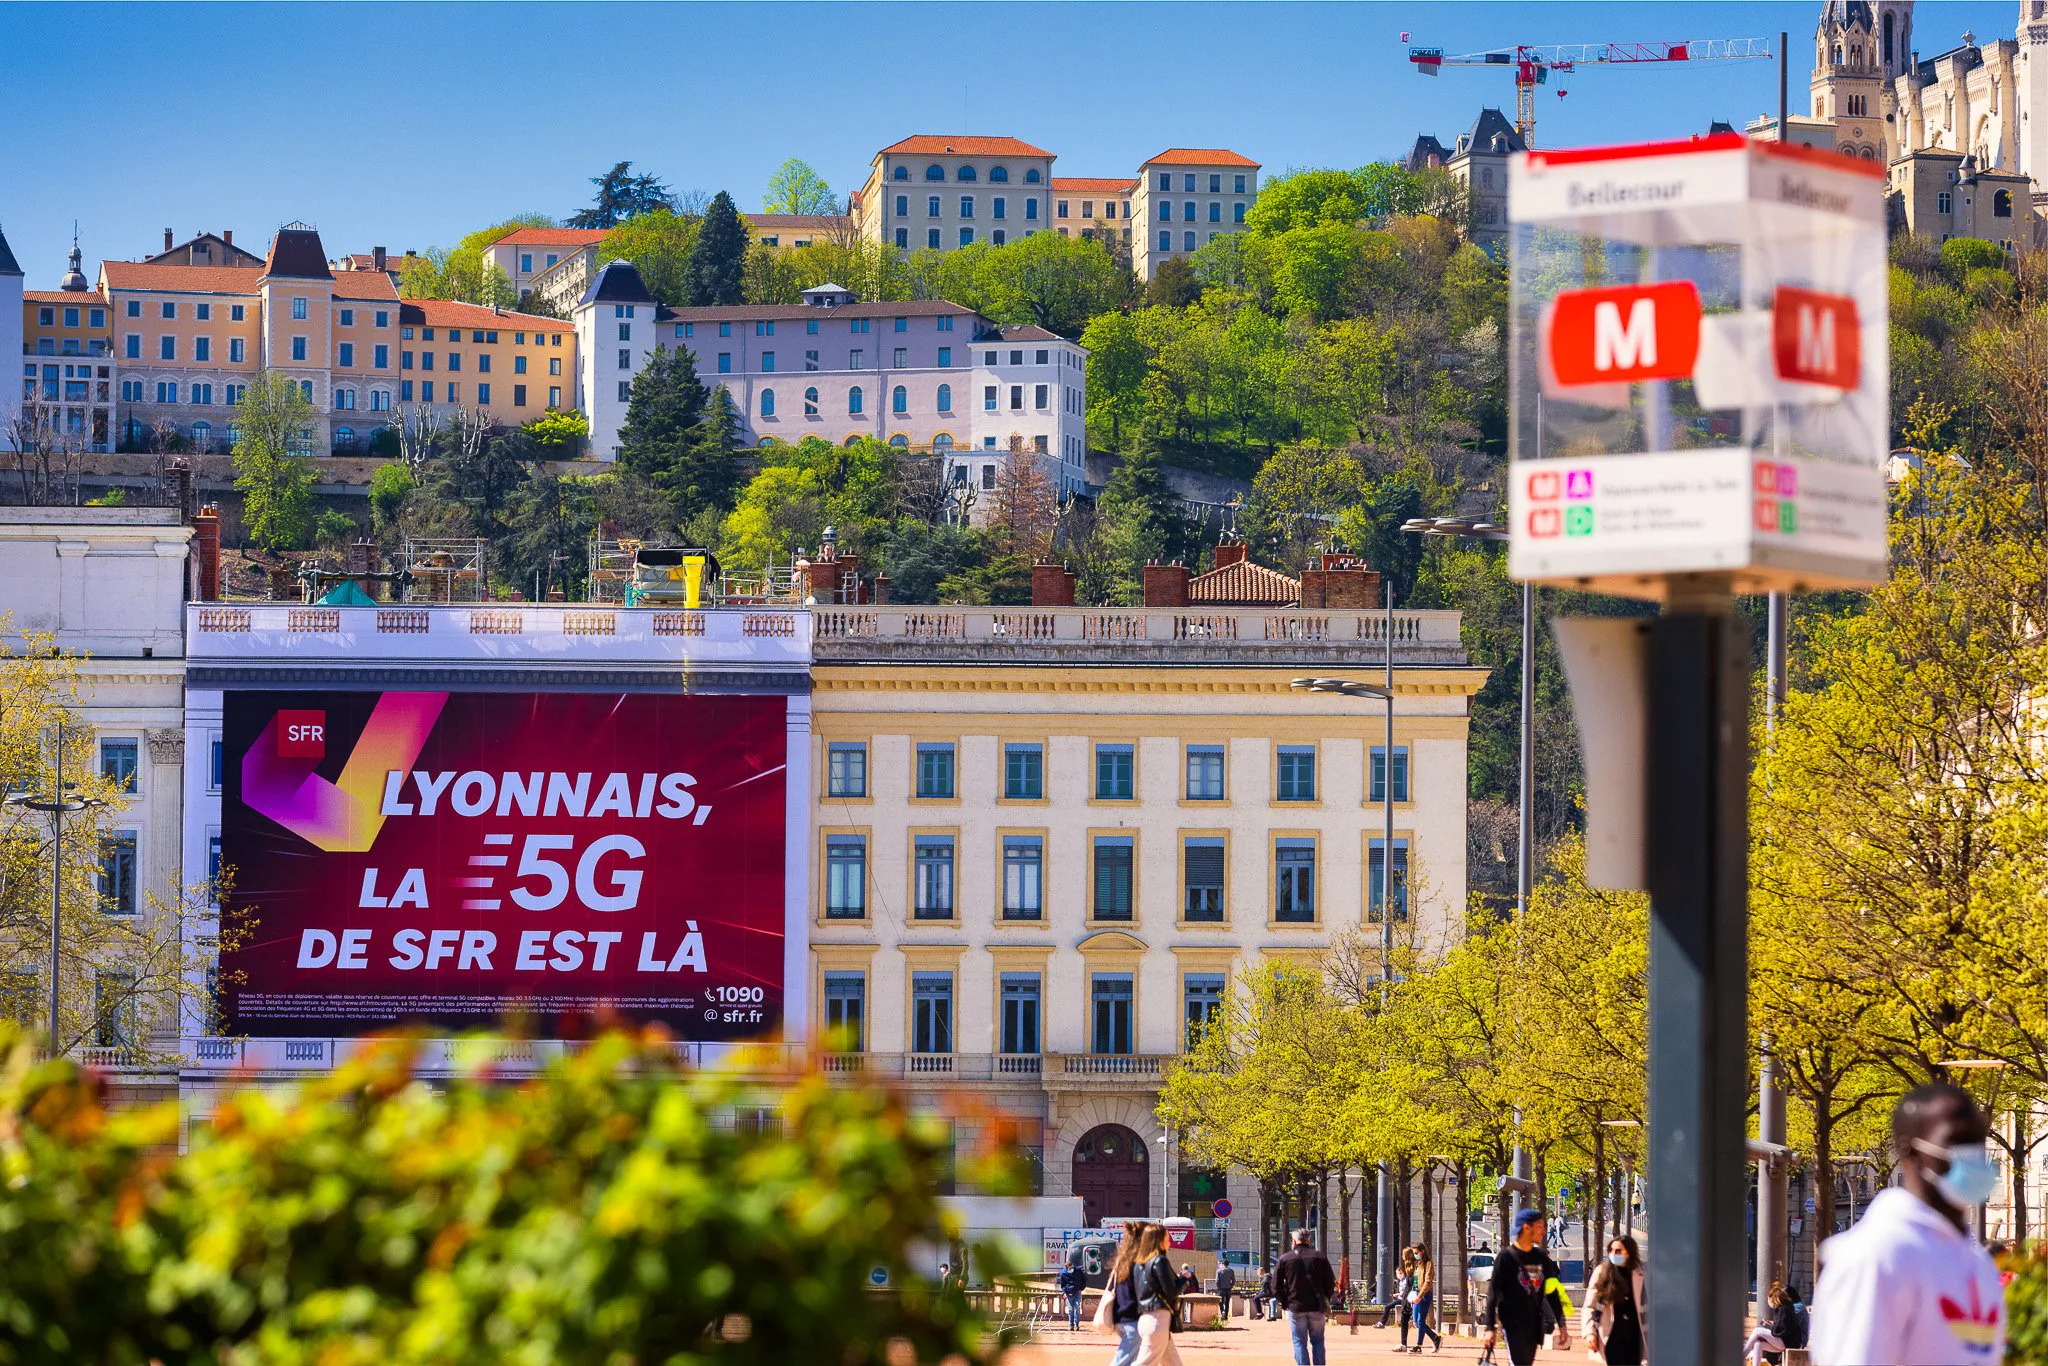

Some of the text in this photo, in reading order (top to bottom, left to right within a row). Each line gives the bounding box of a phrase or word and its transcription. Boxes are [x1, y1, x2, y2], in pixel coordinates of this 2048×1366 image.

[1567, 179, 1685, 207] Bellecour
[1593, 297, 1657, 371] M
[1796, 300, 1836, 375] M
[288, 724, 324, 742] SFR
[380, 770, 713, 826] LYONNAIS,
[358, 833, 647, 912] LA 5G
[297, 920, 708, 973] DE SFR EST LÀ
[716, 986, 764, 1003] 1090
[724, 1010, 763, 1023] sfr.fr
